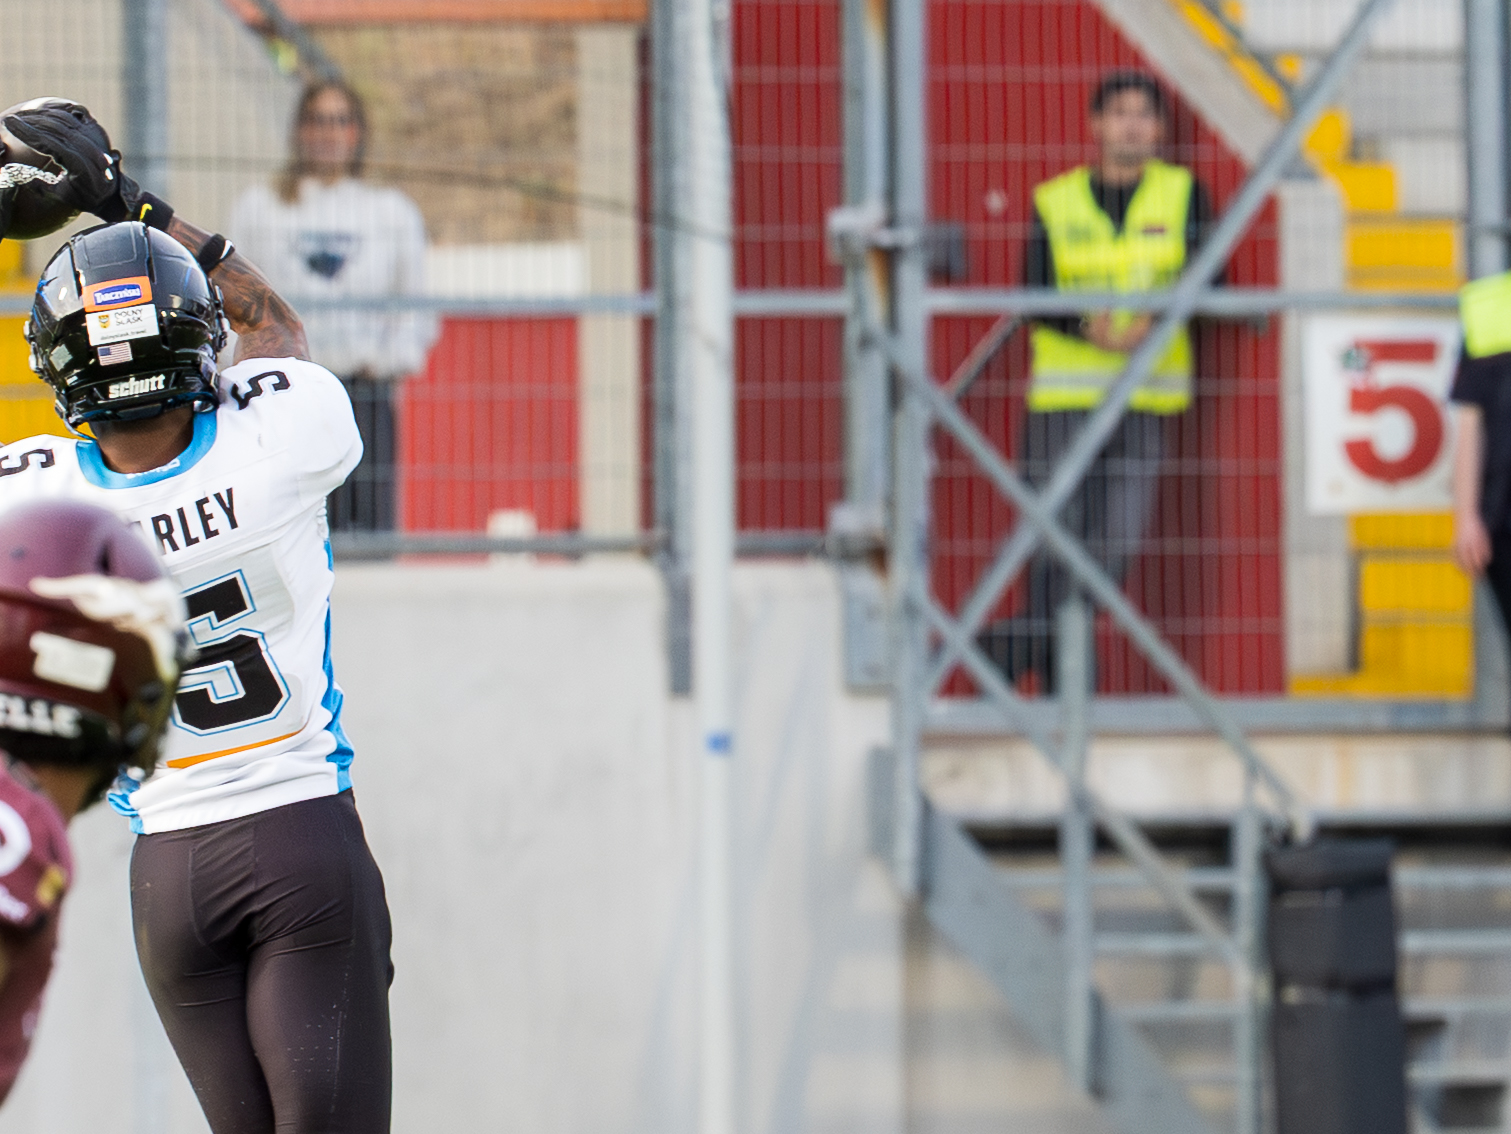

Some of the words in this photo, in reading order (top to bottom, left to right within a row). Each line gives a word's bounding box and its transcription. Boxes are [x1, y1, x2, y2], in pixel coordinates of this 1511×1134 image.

[108, 373, 166, 399] schutt
[1344, 339, 1446, 486] 5
[128, 487, 239, 556] RLEY
[173, 569, 291, 737] 5
